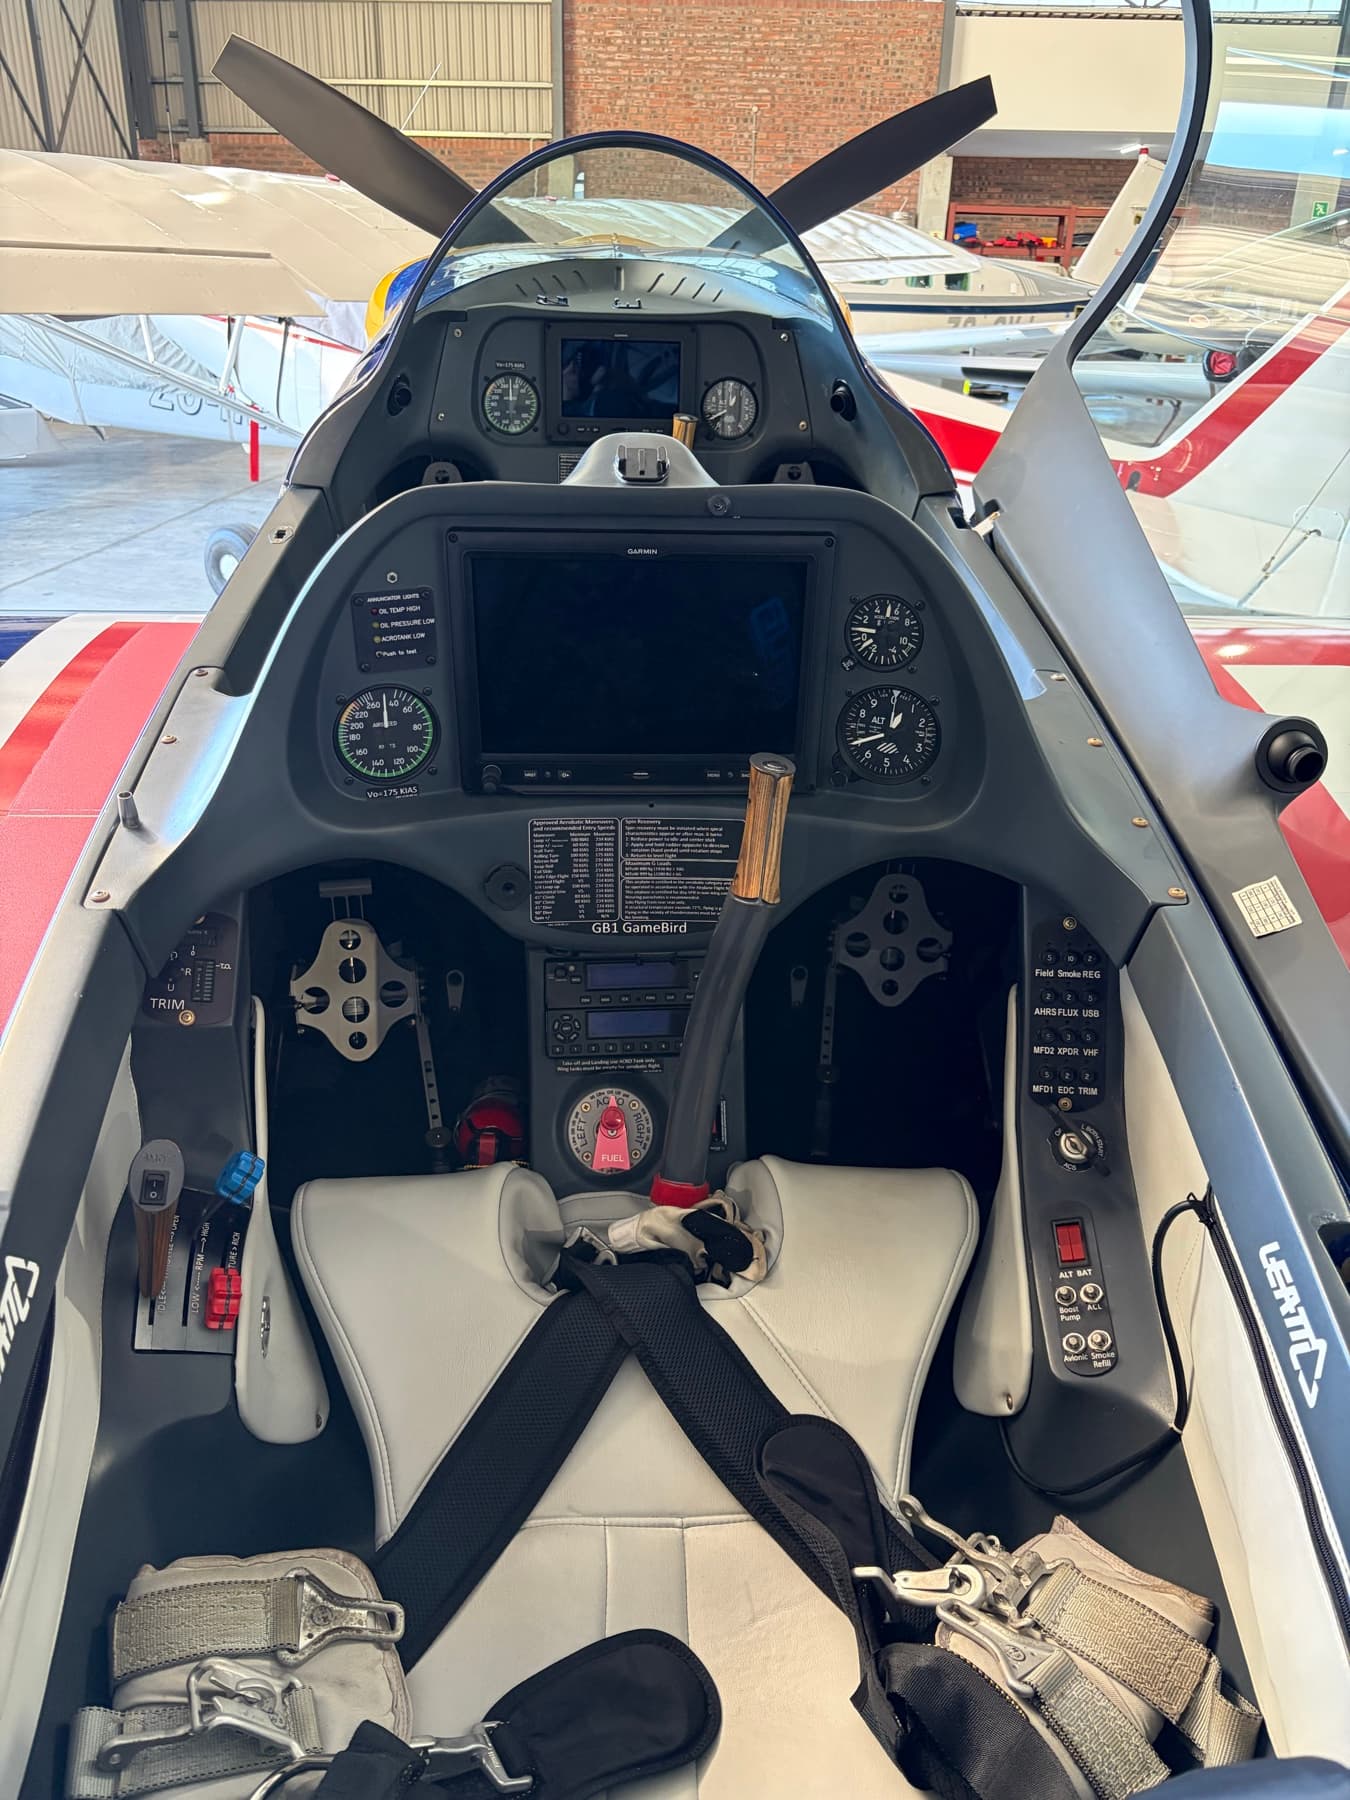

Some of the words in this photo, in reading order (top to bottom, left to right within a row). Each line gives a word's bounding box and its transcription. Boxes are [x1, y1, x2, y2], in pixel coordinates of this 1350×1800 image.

[905, 618, 910, 626] 8
[862, 633, 867, 641] 0
[900, 637, 908, 645] 10
[871, 699, 877, 708] 9
[355, 711, 368, 719] 220
[860, 709, 865, 718] 8
[872, 716, 886, 725] ALT
[919, 718, 925, 727] 2
[350, 722, 364, 730] 200
[356, 748, 368, 756] 160
[915, 743, 923, 752] 3
[865, 750, 872, 758] 6
[883, 758, 890, 767] 5
[903, 755, 910, 764] 4
[400, 786, 418, 795] KIAS
[592, 922, 618, 933] GB1
[623, 922, 687, 933] GameBird
[186, 968, 192, 976] R
[1035, 969, 1054, 977] Field
[1058, 970, 1081, 978] Smoke
[1082, 970, 1101, 979] REG
[150, 998, 185, 1010] TRIM
[1034, 1008, 1057, 1016] AHRS
[1058, 1008, 1079, 1017] FLUX
[1082, 1009, 1099, 1017] USB
[1033, 1046, 1054, 1055] MFD2
[1058, 1047, 1079, 1056] XPDR
[1083, 1048, 1099, 1056] VHF
[1032, 1085, 1053, 1093] MFD1
[1058, 1086, 1075, 1094] EDC
[1078, 1087, 1098, 1095] TRIM
[596, 1097, 625, 1108] ACO
[577, 1117, 588, 1147] LEFT
[633, 1113, 645, 1146] RIGHT
[601, 1154, 624, 1162] FUEL
[200, 1222, 211, 1238] HIGH
[232, 1231, 241, 1245] RICH
[194, 1251, 205, 1271] RPM
[227, 1250, 238, 1268] TURE
[1059, 1271, 1073, 1279] ALT
[1076, 1269, 1092, 1277] BAT
[191, 1290, 200, 1313] LOW
[1059, 1306, 1079, 1314] Boost
[1060, 1314, 1080, 1322] Pump
[1064, 1353, 1088, 1362] Avionic
[1091, 1352, 1115, 1361] Smoke
[1093, 1360, 1112, 1368] Refill
